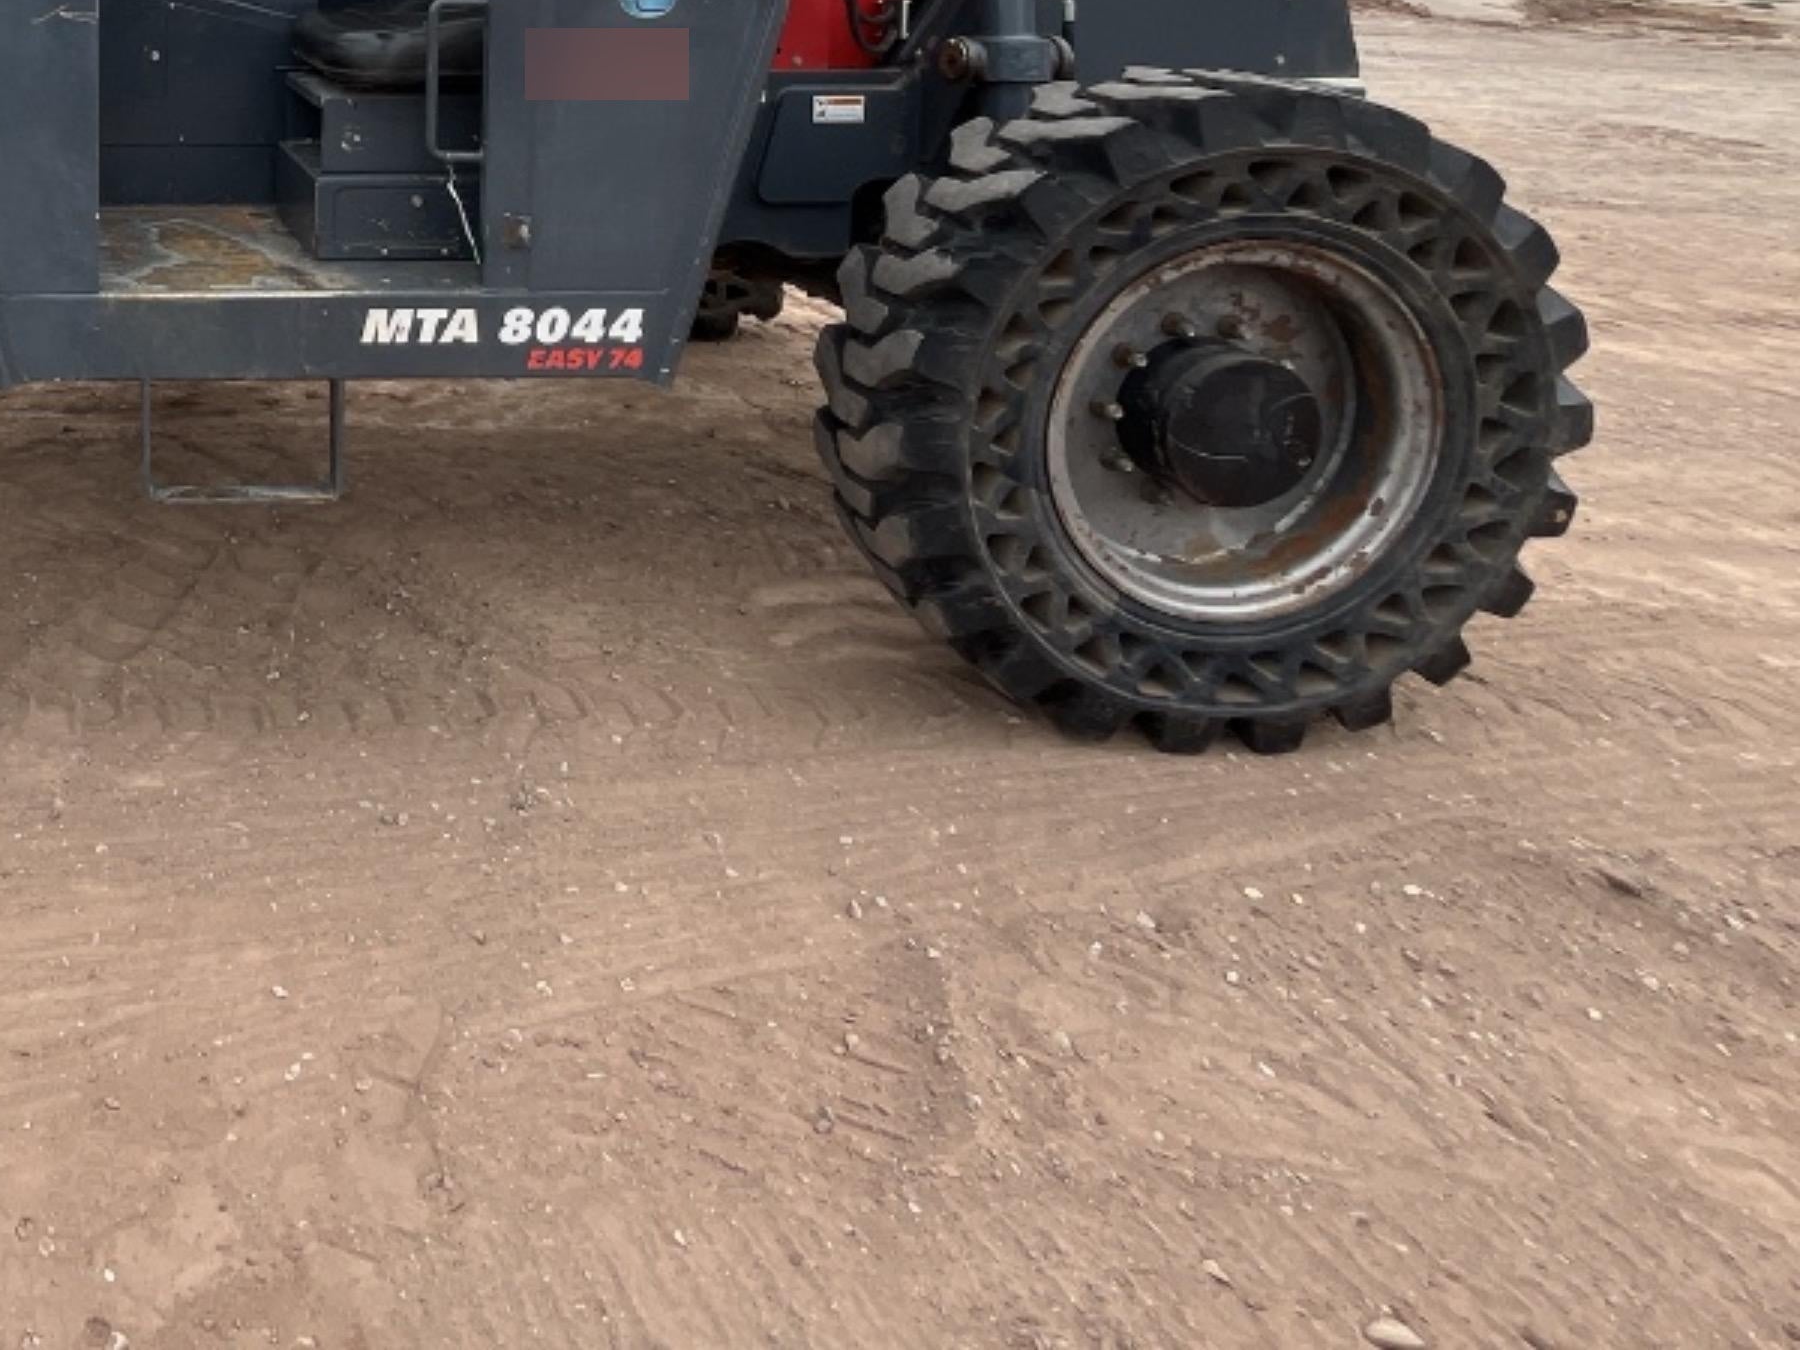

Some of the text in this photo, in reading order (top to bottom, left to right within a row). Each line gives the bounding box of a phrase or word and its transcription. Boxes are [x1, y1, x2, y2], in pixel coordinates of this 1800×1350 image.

[360, 306, 645, 345] MTA 8044
[527, 348, 644, 370] EASY 74
